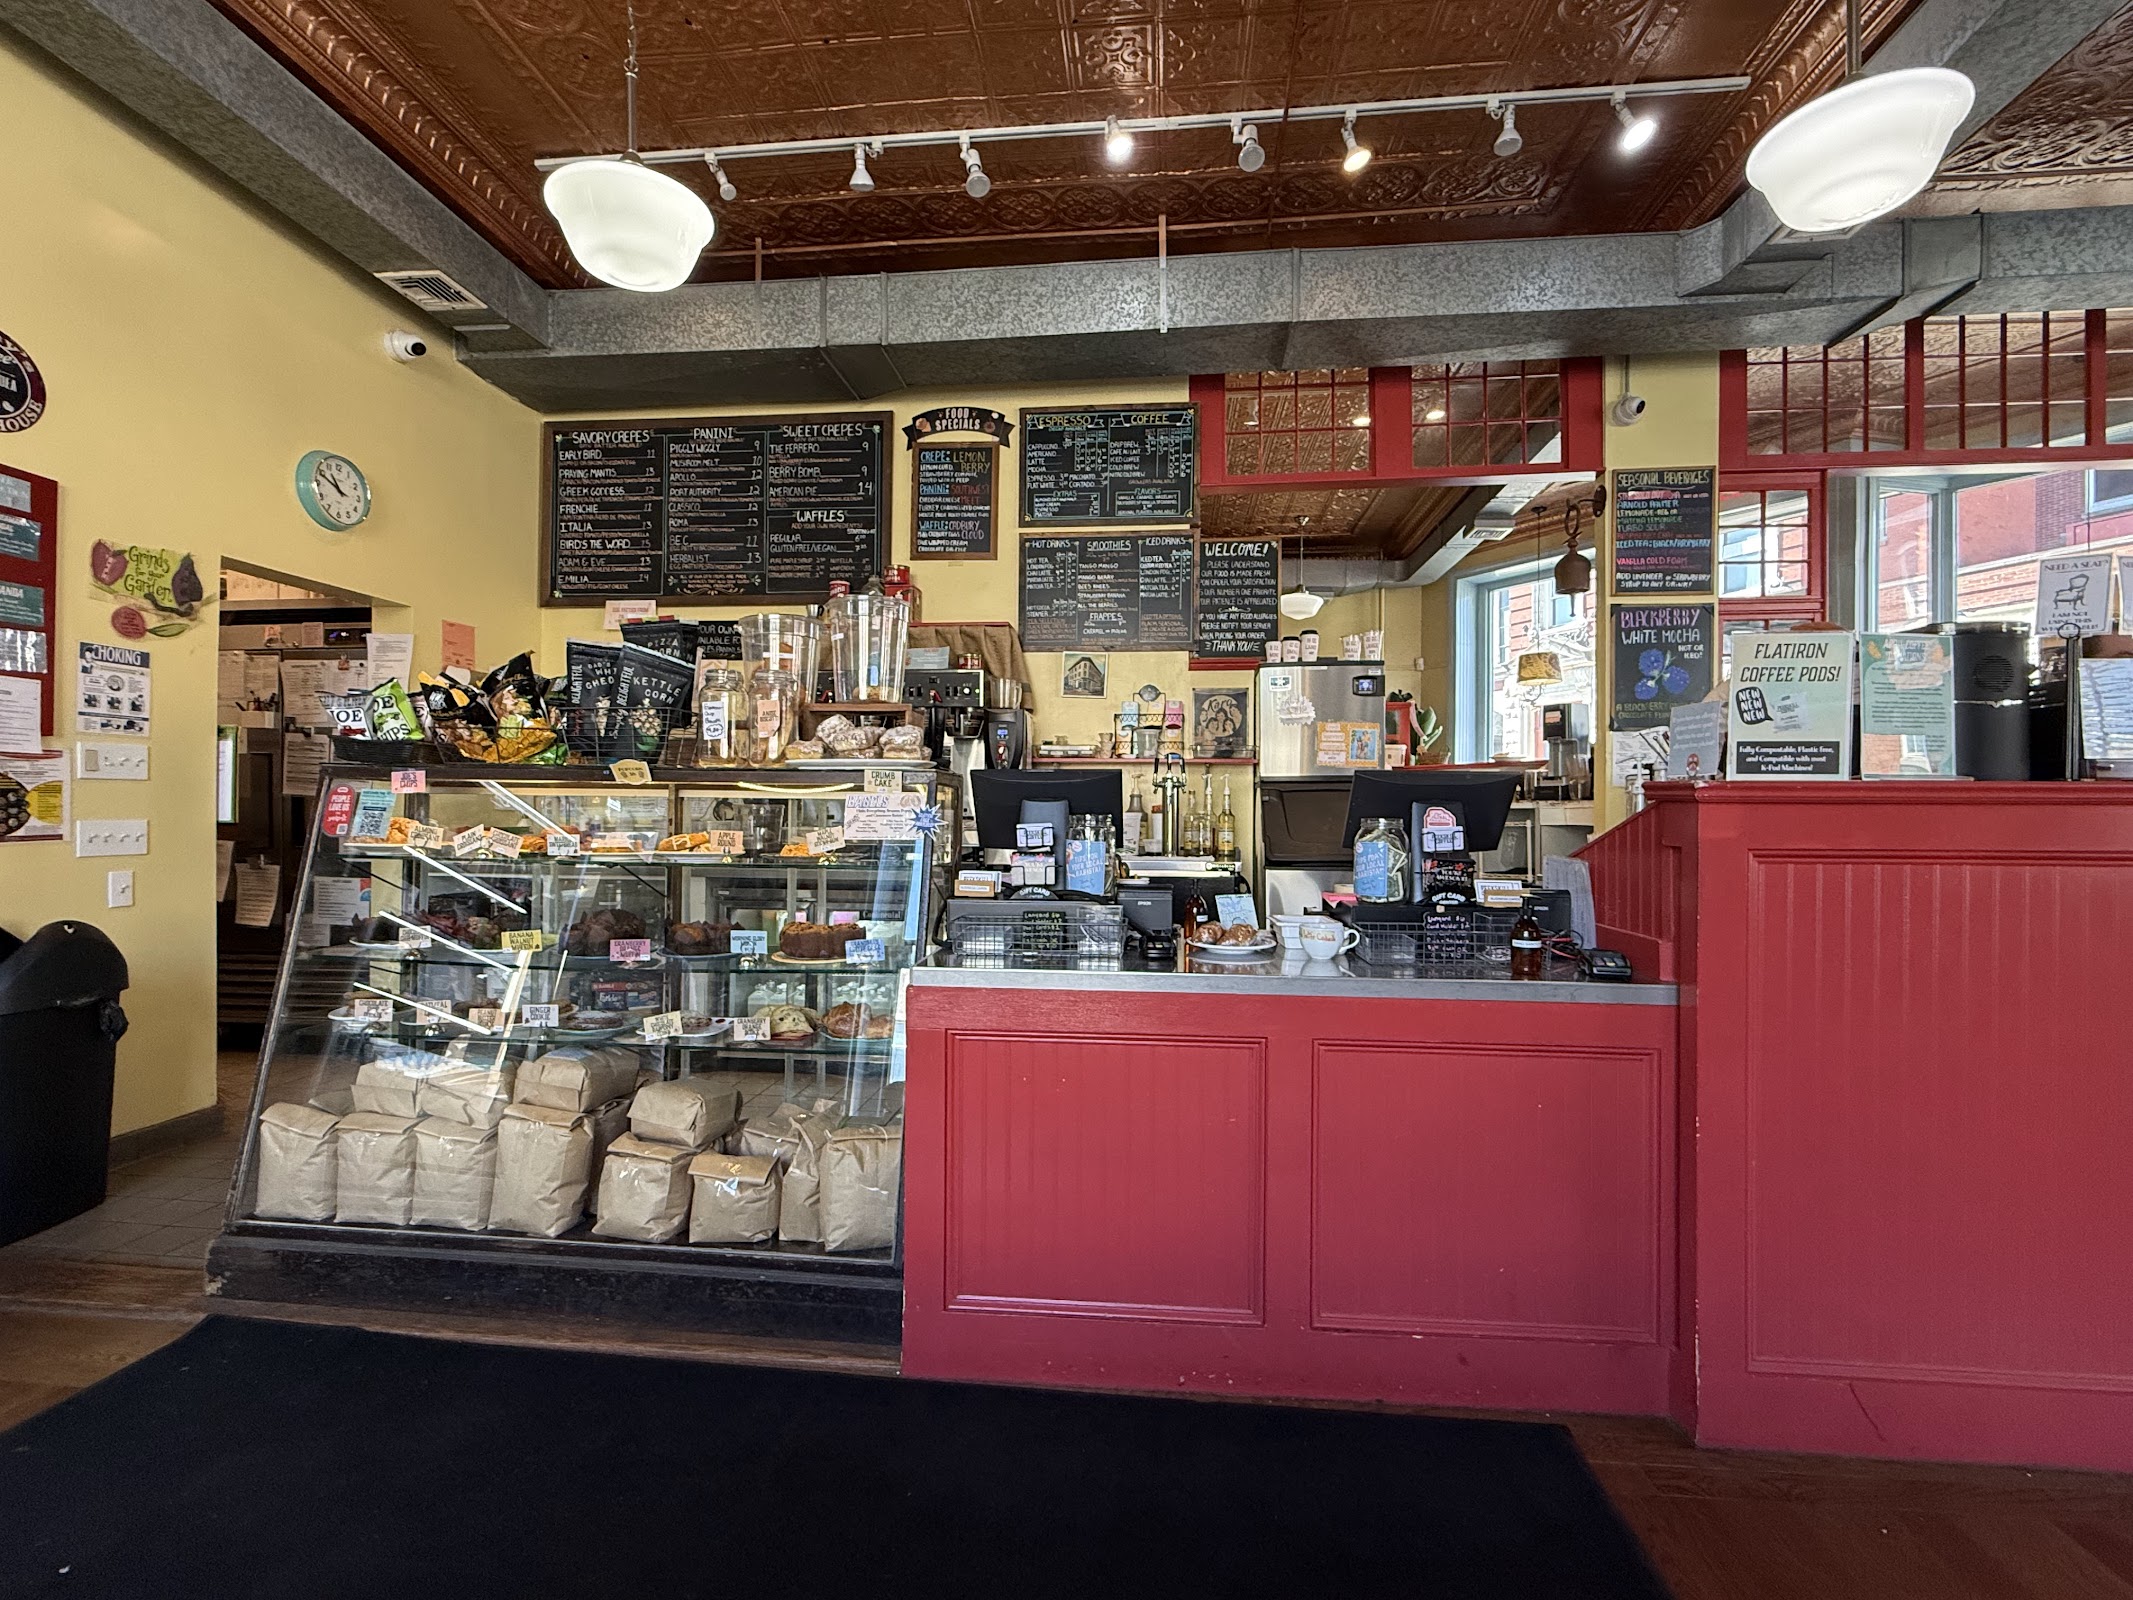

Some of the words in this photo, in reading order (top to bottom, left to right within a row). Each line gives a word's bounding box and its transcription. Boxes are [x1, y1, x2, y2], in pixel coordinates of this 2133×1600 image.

[945, 408, 969, 419] FOOD
[1131, 414, 1169, 424] COFFEE
[935, 419, 980, 431] SPECIALS
[1039, 415, 1091, 427] ESPRESSO
[693, 427, 733, 439] PANINI
[782, 425, 820, 437] SWEET
[821, 423, 863, 436] CREPES
[572, 431, 612, 444] SAVORY
[612, 429, 650, 443] CREPES
[769, 444, 784, 454] THE
[785, 443, 820, 453] FERRERO
[560, 450, 582, 461] EARLY
[583, 449, 602, 460] BIRD
[921, 450, 950, 461] CREPE:
[953, 451, 986, 462] LEMON
[560, 468, 589, 478] PRAYING
[590, 467, 617, 478] MANTIS
[670, 473, 696, 481] APOLLO
[769, 466, 797, 478] BERRY
[797, 467, 821, 478] BOMB
[1618, 474, 1662, 487] SEASONAL
[1664, 470, 1710, 485] BEVERAGES
[560, 487, 589, 497] GREEK
[670, 488, 688, 496] PORT
[689, 487, 721, 496] AUTHORITY
[769, 486, 804, 496] AMERICAN
[805, 486, 818, 496] PIE
[857, 481, 872, 495] 14
[560, 504, 598, 514] FRENCHIE
[668, 502, 700, 512] CLASSICO
[1617, 501, 1648, 509] ARNOLD
[797, 510, 845, 522] WAFFLES
[560, 522, 593, 532] ITALIA
[669, 518, 688, 527] ROMA
[919, 521, 949, 530] WAFFLE:
[770, 534, 801, 542] REGULAR
[1146, 537, 1161, 545] ICED
[1161, 537, 1186, 545] DRINKS
[590, 539, 603, 549] THE
[605, 539, 631, 549] WORD
[1032, 540, 1046, 548] HOT
[1047, 540, 1070, 548] DRINKS
[1087, 540, 1131, 551] SMOOTHIES
[1204, 542, 1268, 557] WELCOME!
[128, 545, 170, 573] Grinds
[559, 558, 580, 566] ADAM
[591, 558, 606, 566] EVE
[669, 554, 709, 563] HERBALIST
[747, 552, 761, 563] 13
[2045, 563, 2069, 571] NEED
[2081, 560, 2108, 568] SEAT?
[559, 575, 589, 583] EMILIA
[124, 574, 173, 602] Garden
[1621, 608, 1700, 628] BLACKBERRY
[1662, 629, 1700, 644] MOCHA
[648, 638, 679, 647] PIZZA
[1212, 640, 1235, 652] THANK
[92, 645, 141, 666] CHOKING
[1754, 643, 1829, 659] FLATIRON
[1740, 667, 1796, 682] COFFEE
[1798, 666, 1841, 682] PODS!
[633, 677, 682, 697] KETTLE
[645, 689, 675, 704] CORN
[1738, 689, 1761, 701] NEW
[1740, 699, 1763, 711] NEW
[1743, 710, 1765, 722] NEW
[1739, 746, 1755, 754] Fully
[1760, 755, 1795, 763] Compatible
[400, 772, 417, 780] JOE'S
[871, 771, 896, 780] CRUMB
[874, 779, 892, 788] CAKE
[846, 795, 889, 808] BAGELS
[719, 832, 736, 840] APPLE
[717, 839, 736, 847] ROUND
[1033, 887, 1051, 896] CARD
[509, 931, 534, 940] BANANA
